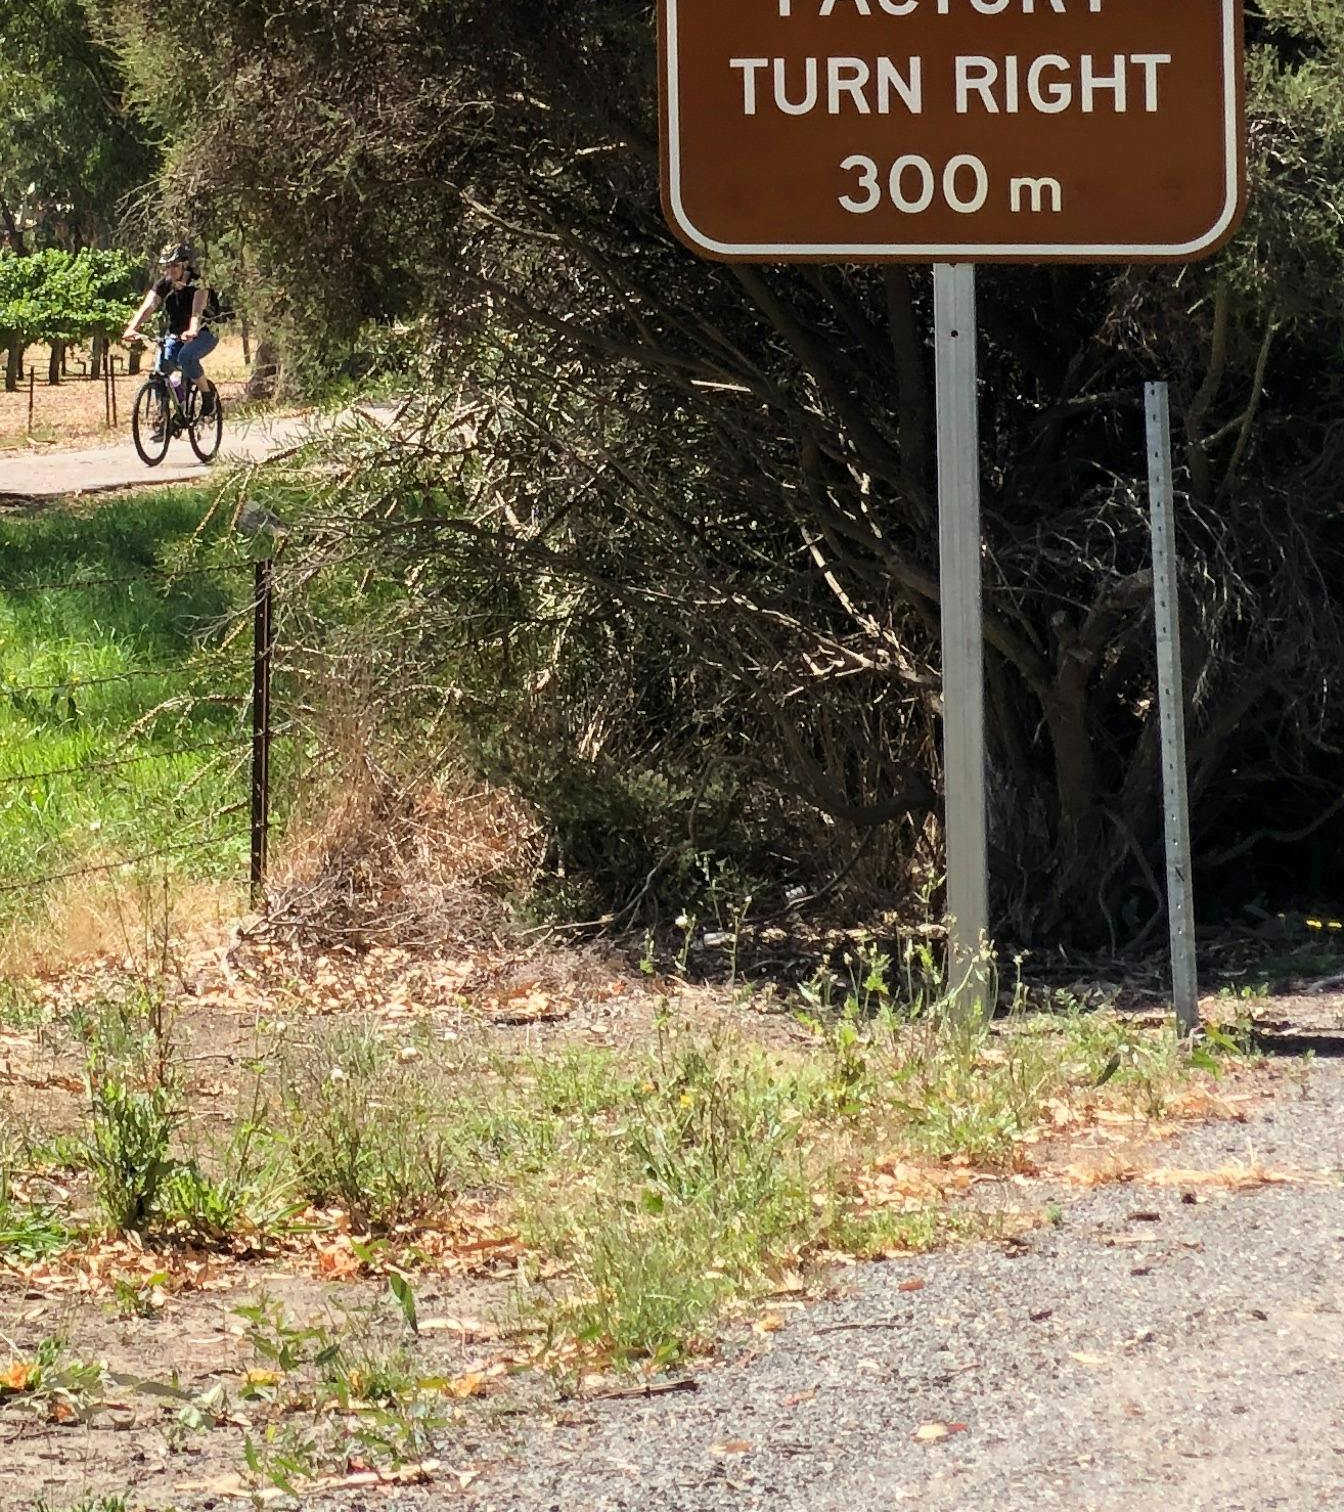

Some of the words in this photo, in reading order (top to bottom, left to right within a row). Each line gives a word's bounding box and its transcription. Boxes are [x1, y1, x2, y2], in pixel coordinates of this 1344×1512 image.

[728, 56, 922, 115] TURN
[955, 53, 1172, 114] RIGHT
[838, 154, 988, 213] 300
[1010, 176, 1062, 212] m
